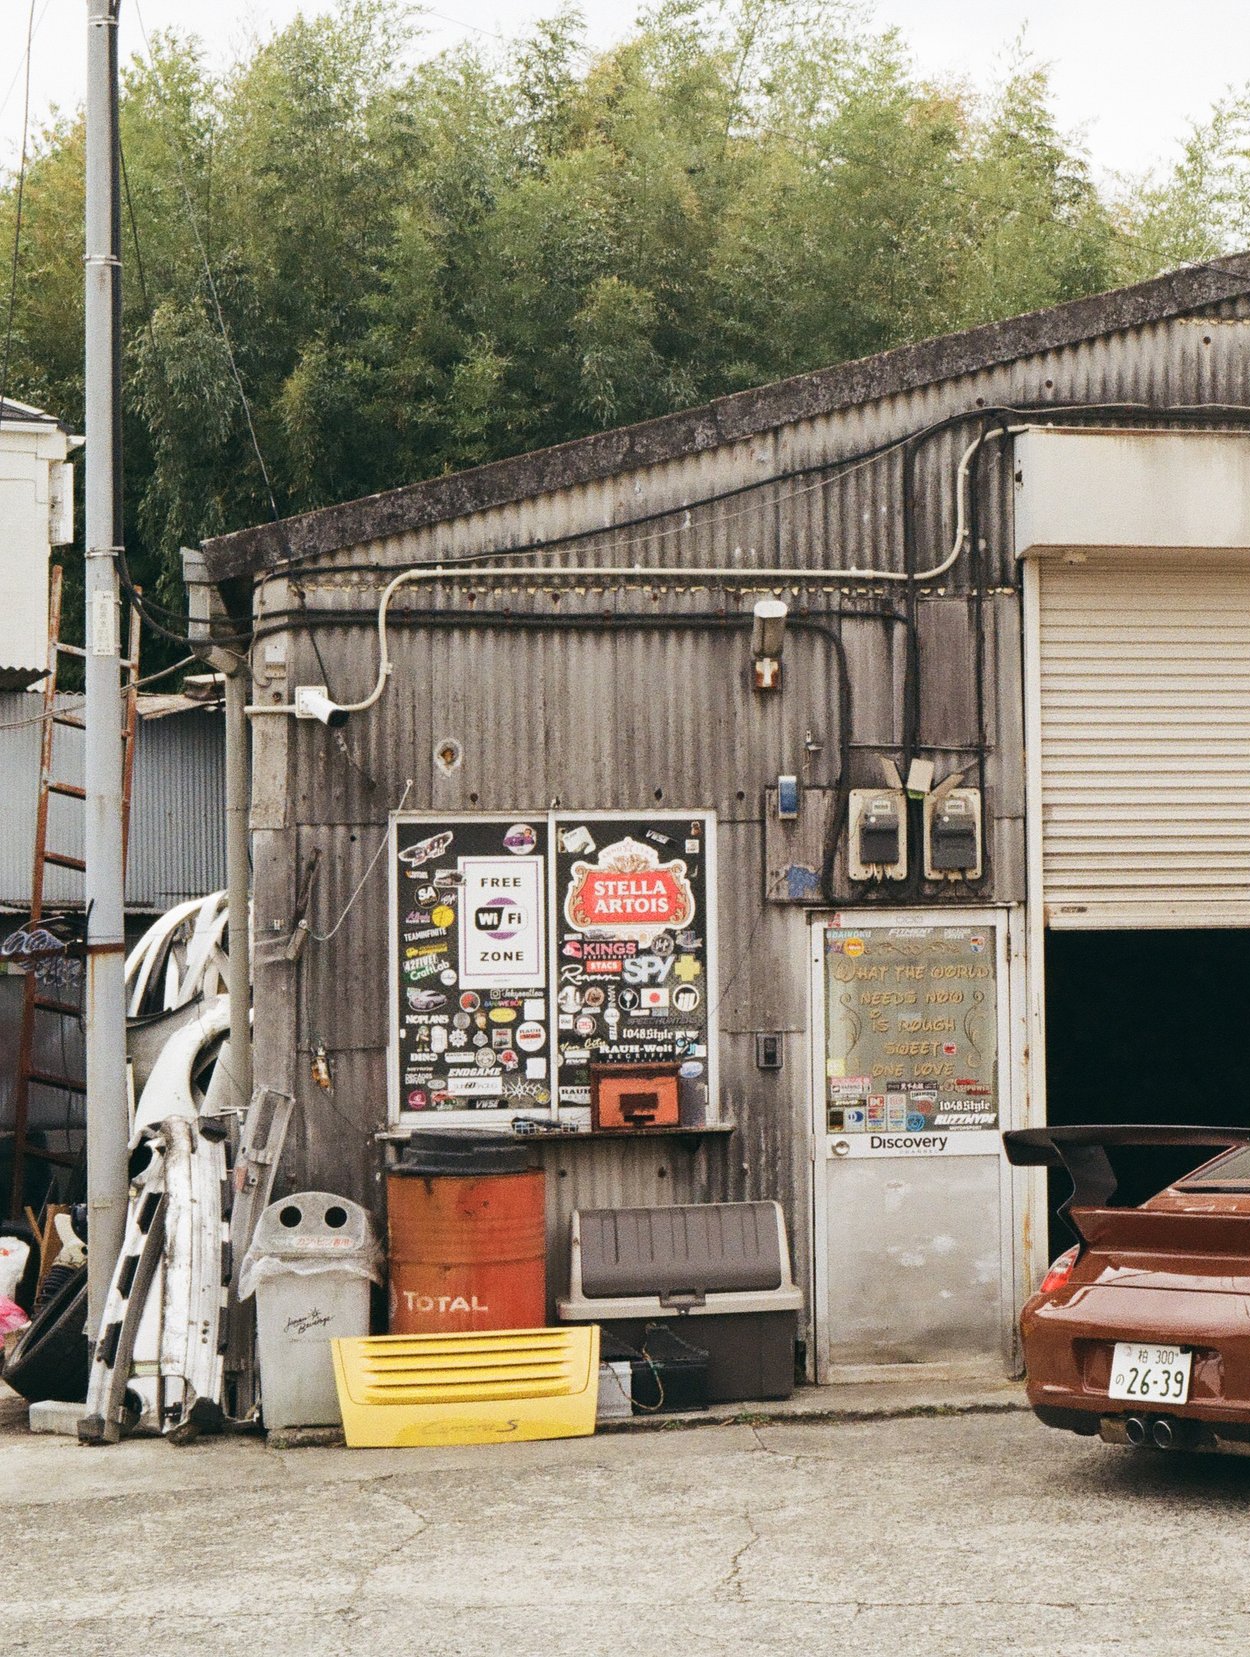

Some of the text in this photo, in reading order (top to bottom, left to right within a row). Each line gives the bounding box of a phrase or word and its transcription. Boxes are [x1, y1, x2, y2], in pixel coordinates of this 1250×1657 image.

[480, 877, 522, 888] FREE
[594, 880, 667, 896] STELLA
[594, 898, 669, 914] ARTOIS
[583, 942, 637, 955] KINGS
[480, 951, 524, 962] ZONE
[622, 954, 676, 984] SPY
[870, 1136, 948, 1151] Discovery
[403, 1290, 489, 1312] TOTAL
[1155, 1350, 1175, 1365] 300
[1126, 1367, 1184, 1398] 26-39
